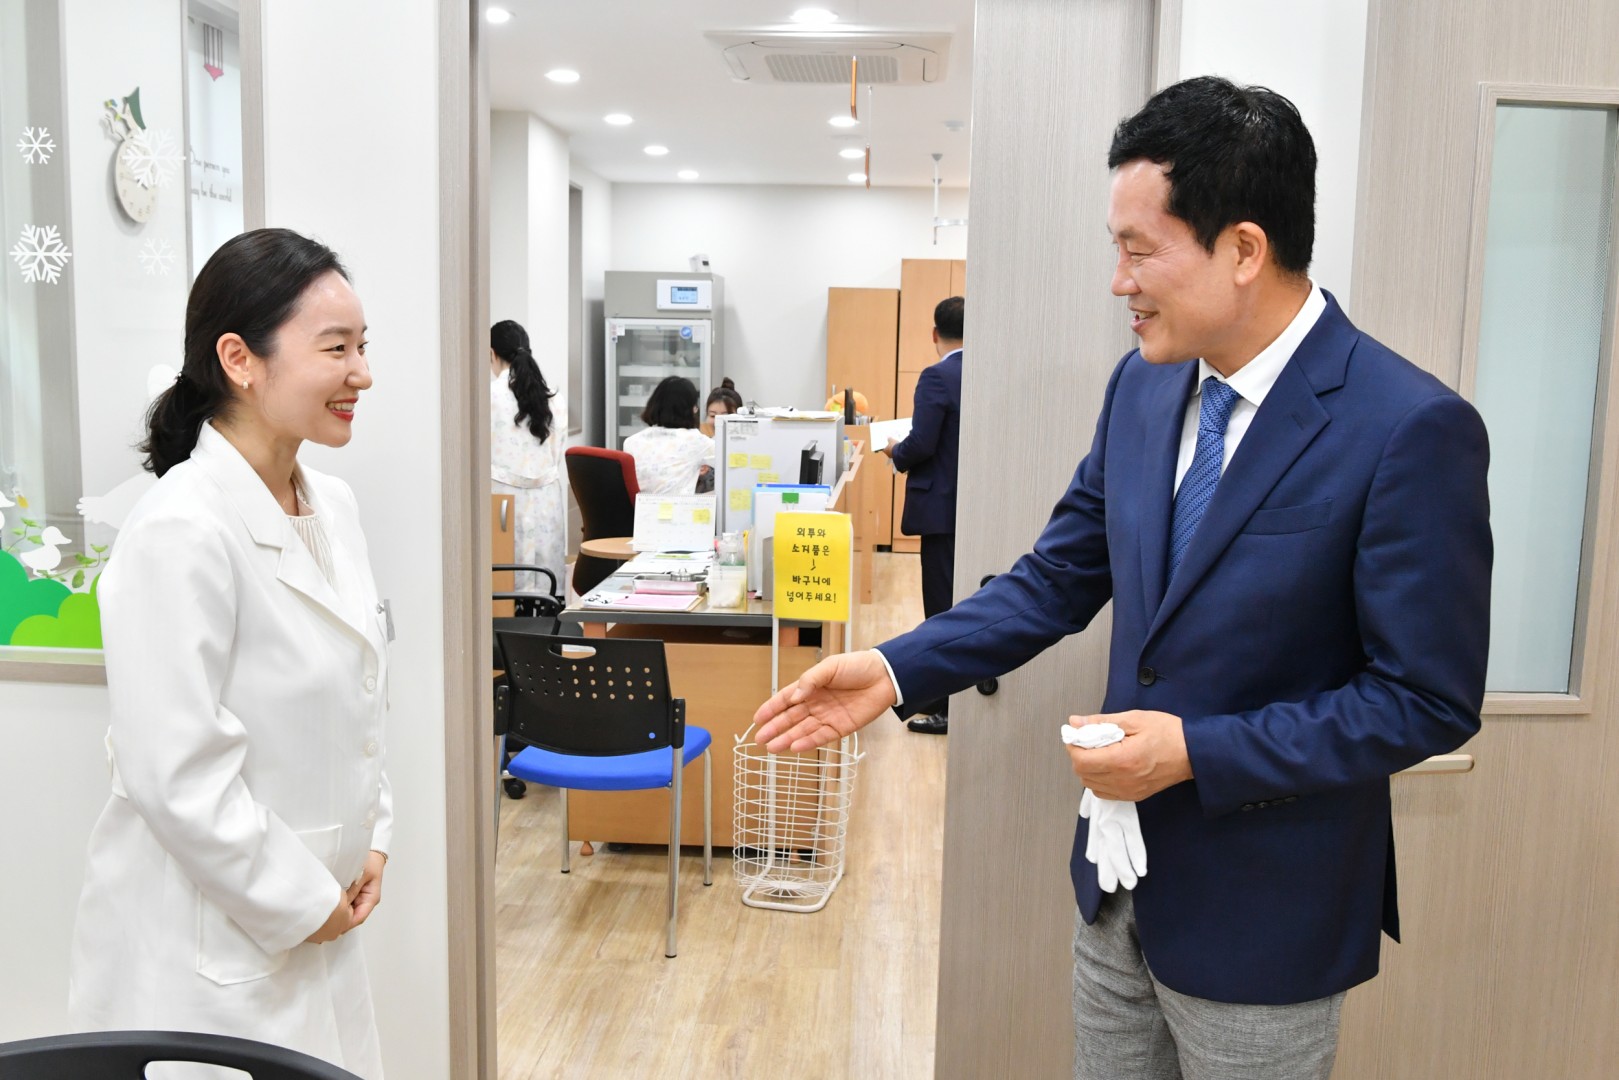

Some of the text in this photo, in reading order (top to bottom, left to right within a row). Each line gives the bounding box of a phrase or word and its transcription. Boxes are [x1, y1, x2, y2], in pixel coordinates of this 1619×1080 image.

[796, 527, 826, 538] 외투와
[792, 543, 830, 556] 소지품은
[792, 575, 831, 586] 바구니에
[786, 591, 837, 603] 넣어주세요!
